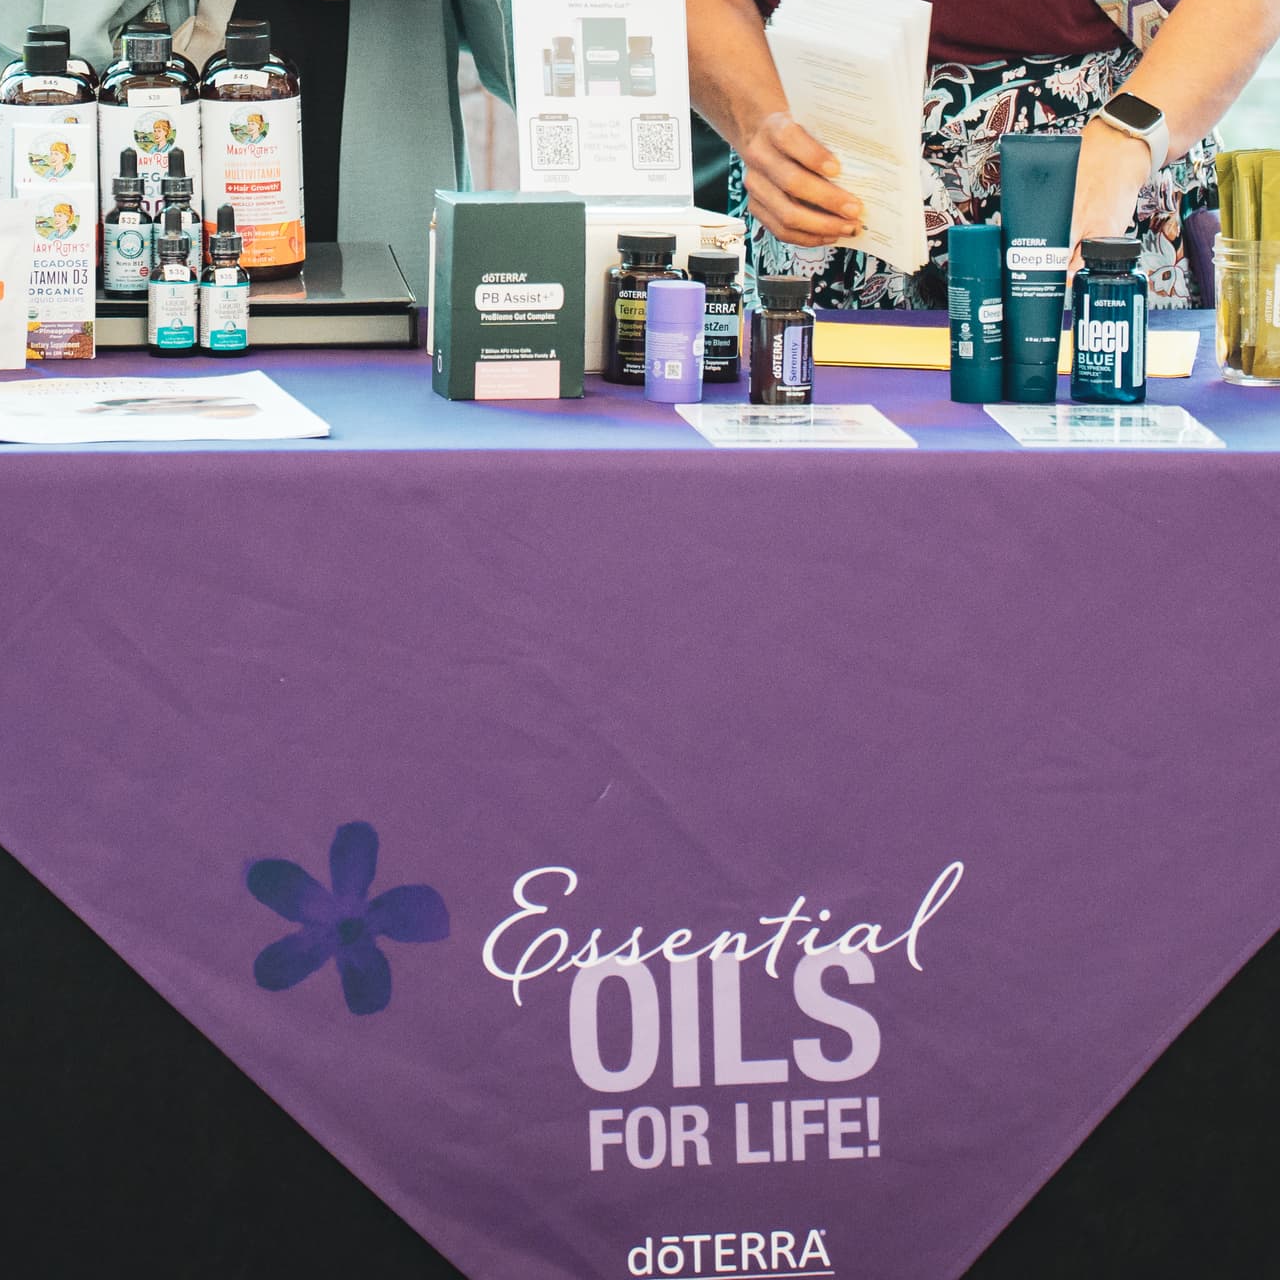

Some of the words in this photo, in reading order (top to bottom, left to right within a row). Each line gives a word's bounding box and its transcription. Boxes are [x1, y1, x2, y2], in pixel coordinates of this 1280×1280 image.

[250, 182, 280, 193] Growth
[120, 216, 138, 225] $32
[32, 259, 89, 268] EGADOSE
[1011, 253, 1043, 265] Deep
[1045, 253, 1069, 265] Blue
[29, 270, 68, 285] ITAMIN
[73, 268, 88, 285] D3
[27, 287, 84, 296] ORGANIC
[619, 289, 648, 299] dōTERR
[481, 292, 500, 304] PB
[619, 303, 646, 315] Terra
[514, 312, 526, 321] Gut
[526, 312, 556, 322] Complex
[1077, 293, 1130, 389] deep
[789, 342, 800, 382] Serenity
[1077, 353, 1115, 367] BLUE
[481, 860, 964, 1007] Essential
[568, 946, 882, 1093] OILS
[587, 1104, 713, 1172] FOR
[734, 1095, 882, 1166] LIFE!
